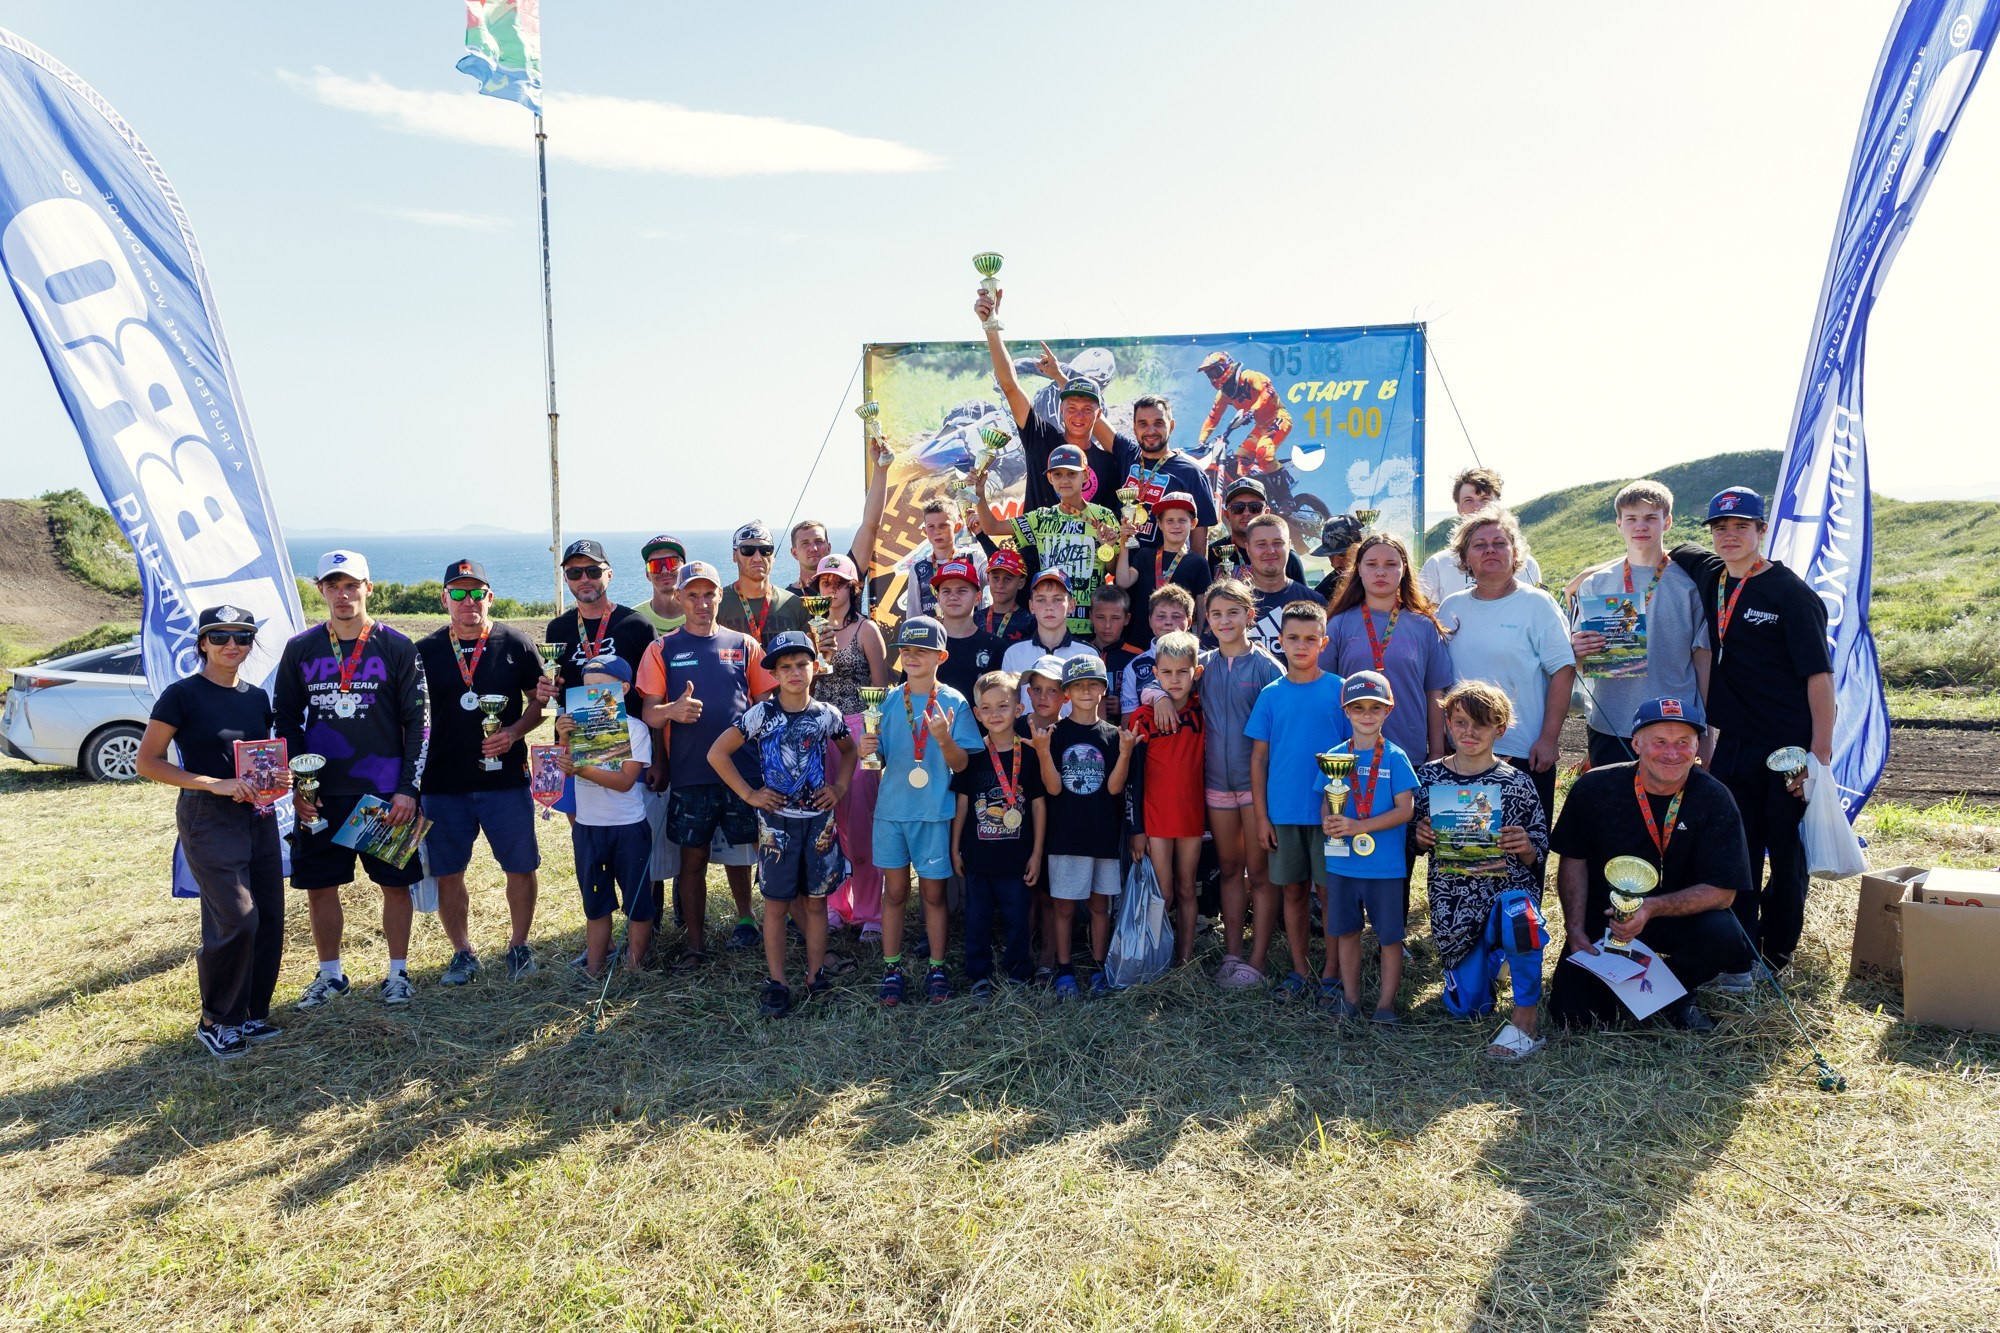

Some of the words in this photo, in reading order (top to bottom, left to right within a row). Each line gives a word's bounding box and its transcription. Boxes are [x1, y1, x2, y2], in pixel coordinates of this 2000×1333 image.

[1816, 381, 1826, 394] A
[1823, 279, 1858, 371] TRUSTED
[1859, 207, 1883, 267] NAME
[1882, 45, 1927, 195] WORLDWIDE
[1287, 379, 1369, 404] СТАРТ
[1377, 379, 1399, 400] В
[1303, 406, 1382, 438] 11-00
[1743, 607, 1780, 621] JEANSWEST
[308, 682, 341, 691] DREAM
[349, 682, 378, 690] TEAM
[980, 826, 997, 834] FOOD
